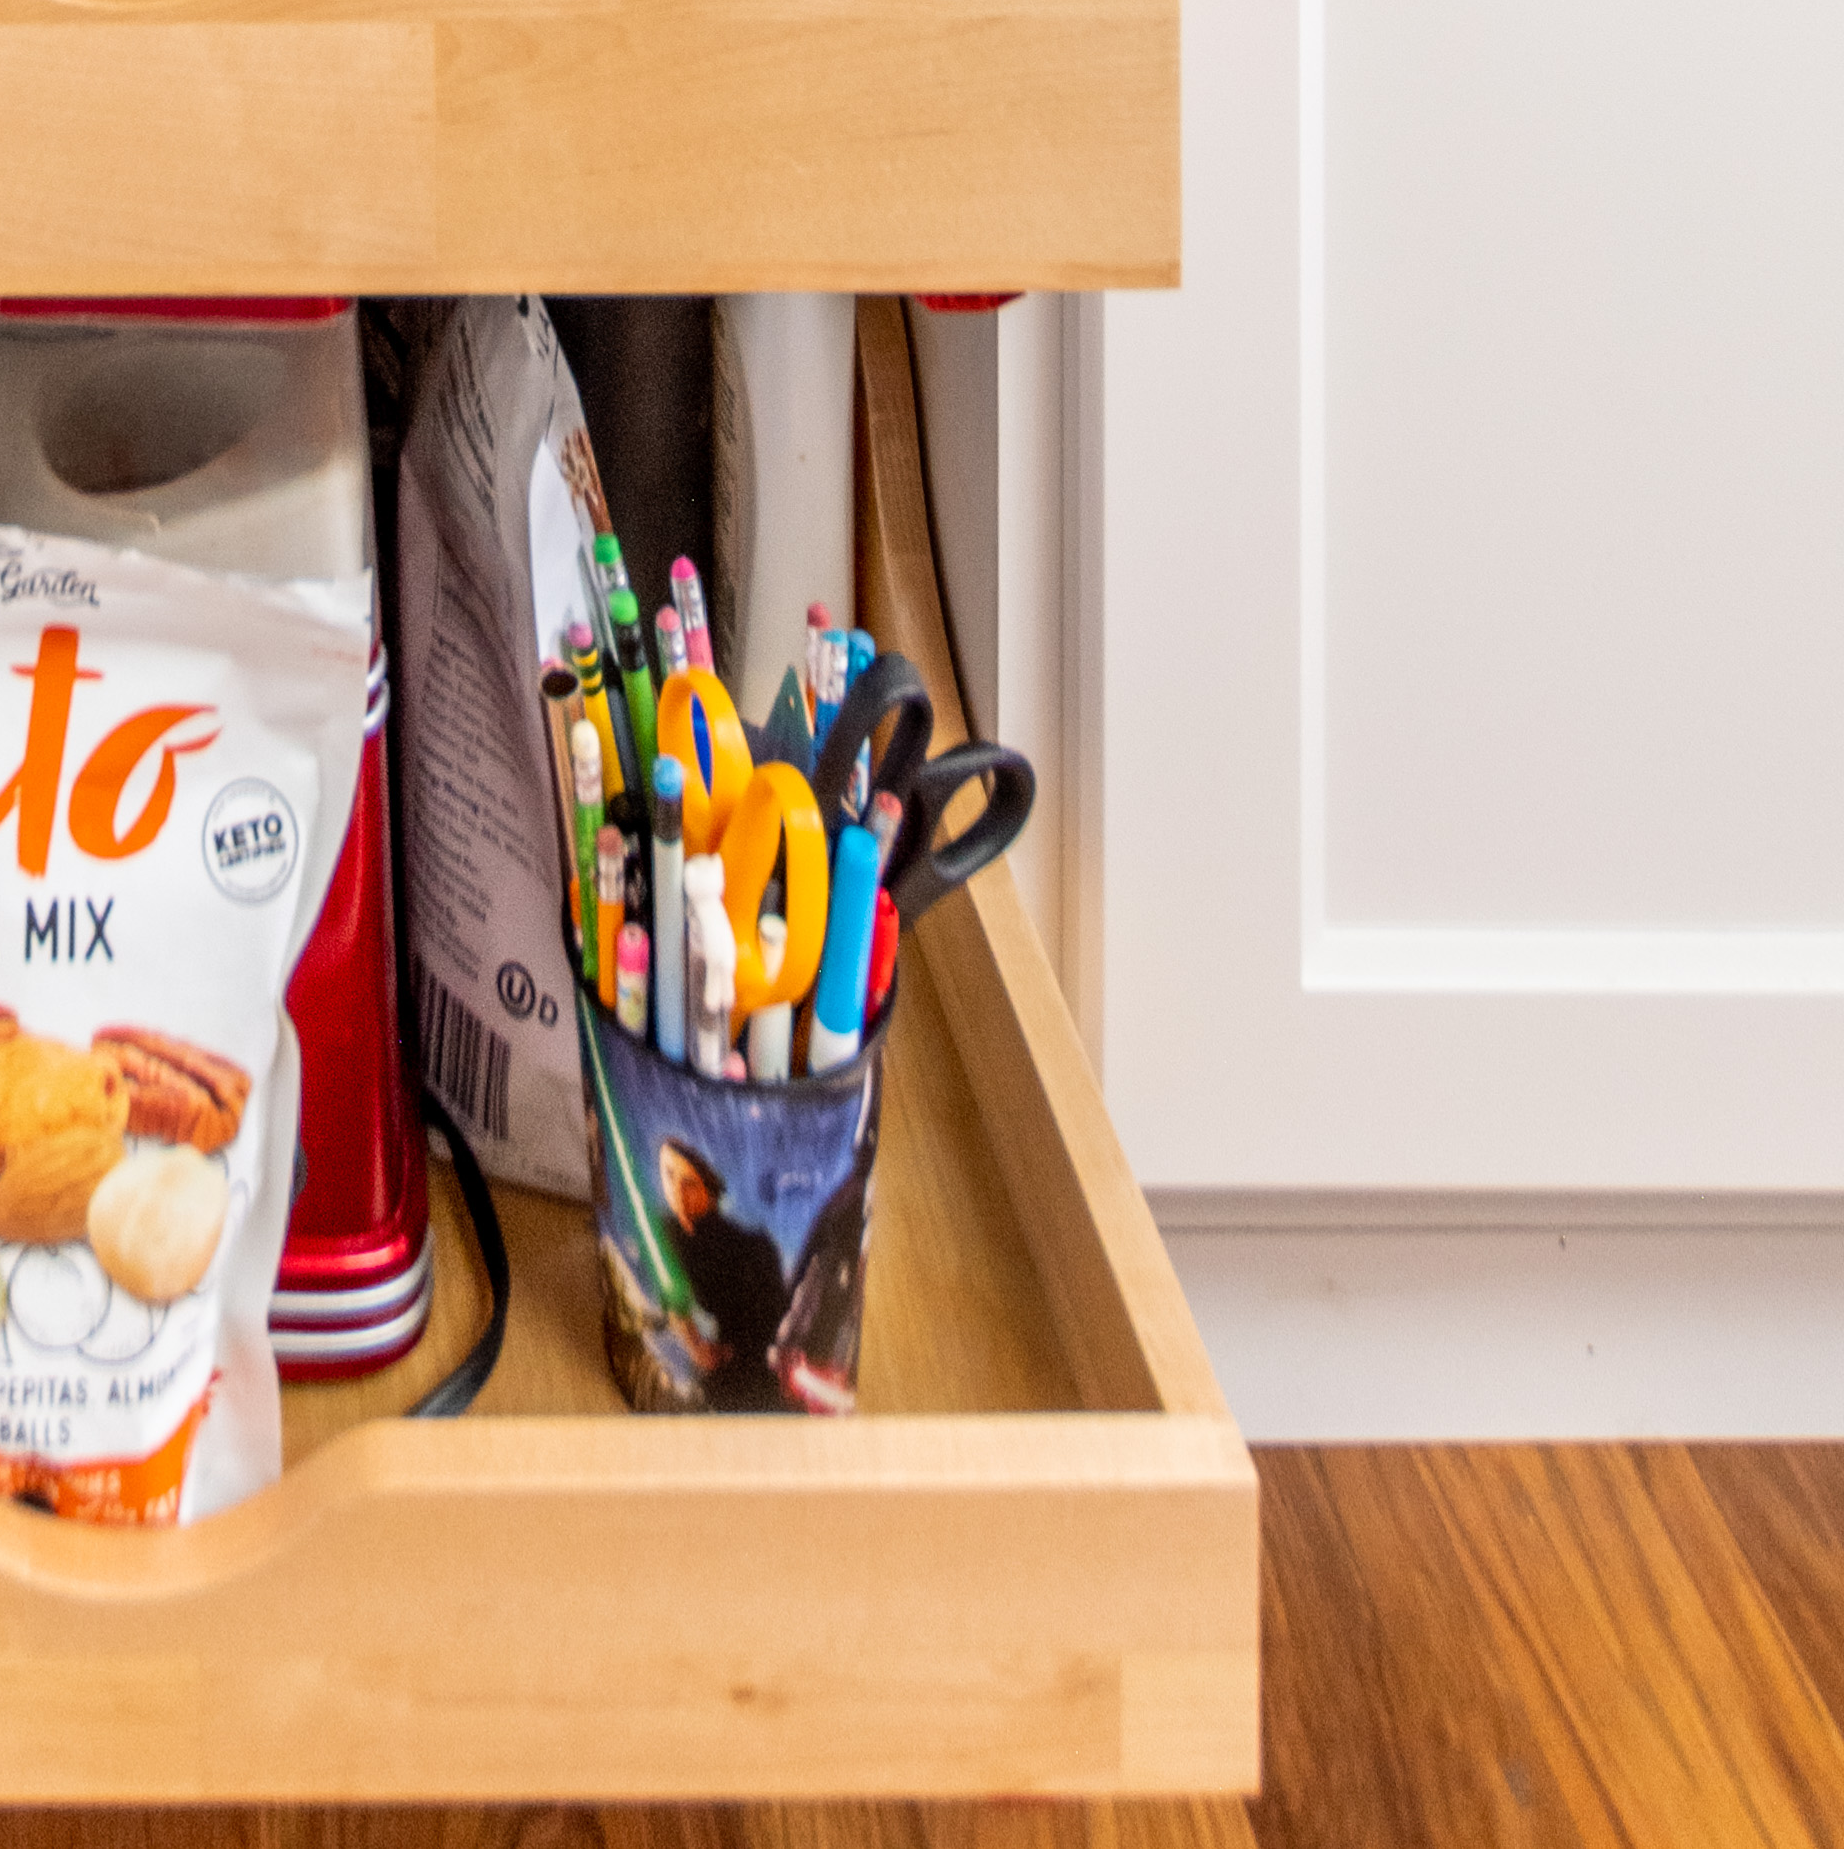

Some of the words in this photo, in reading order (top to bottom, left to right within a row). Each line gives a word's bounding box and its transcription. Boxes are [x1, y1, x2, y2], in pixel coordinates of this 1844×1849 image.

[213, 812, 283, 853] KETO
[24, 894, 116, 964] MIX
[0, 1415, 71, 1447] BALLS
